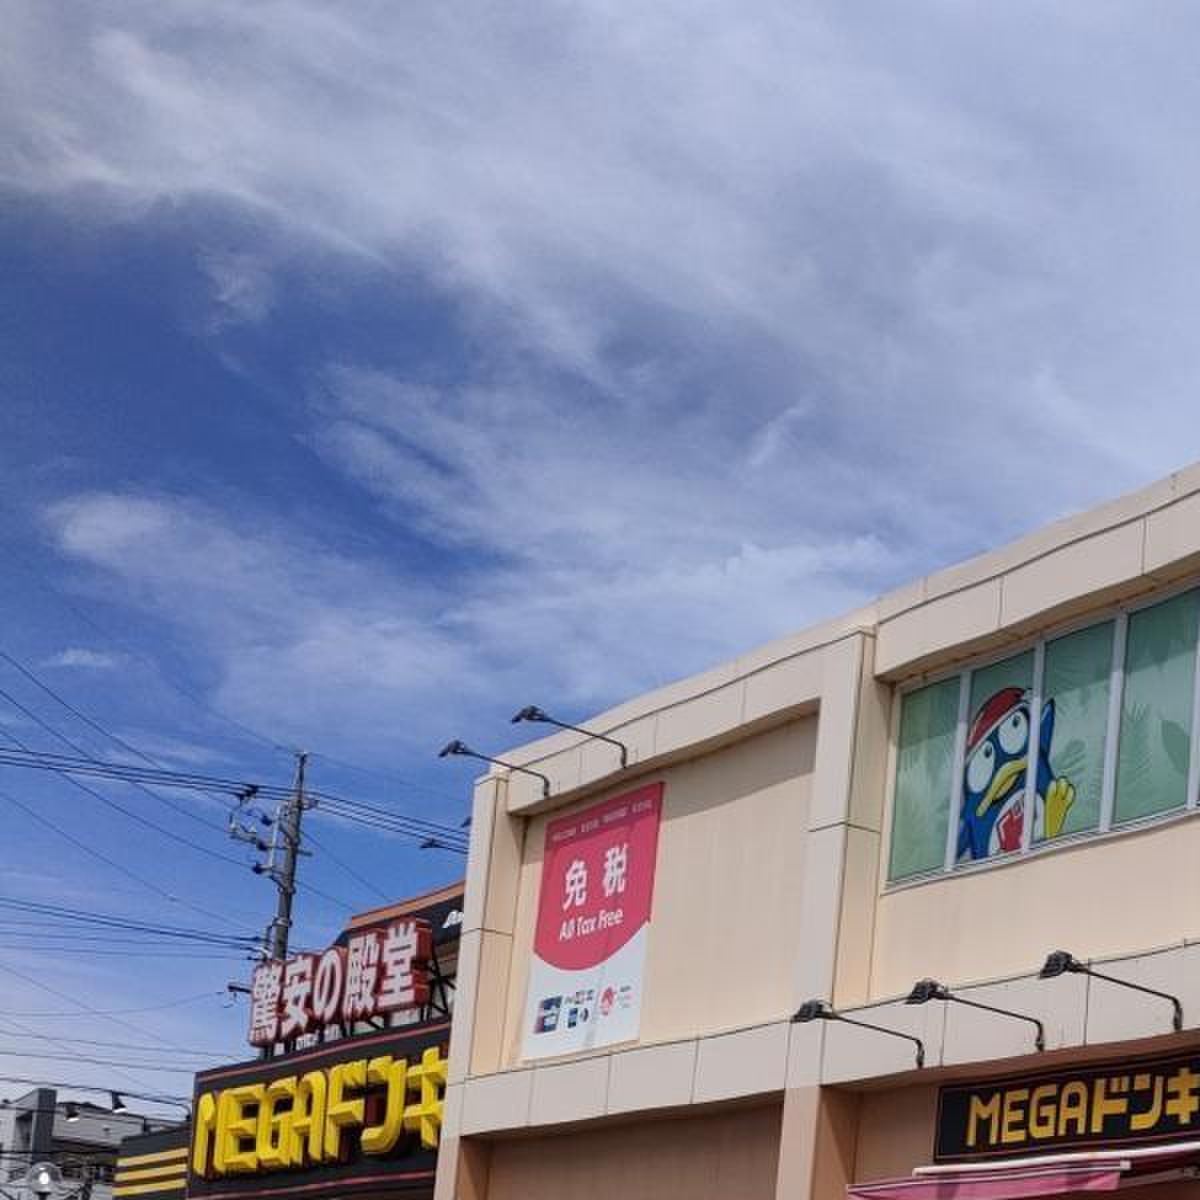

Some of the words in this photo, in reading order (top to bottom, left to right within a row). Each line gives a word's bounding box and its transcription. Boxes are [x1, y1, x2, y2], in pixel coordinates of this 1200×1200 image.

[562, 842, 629, 912] 免税
[558, 918, 576, 943] All
[576, 915, 598, 938] Tax
[598, 907, 625, 931] Free
[965, 1066, 1200, 1147] MEGAドンキ
